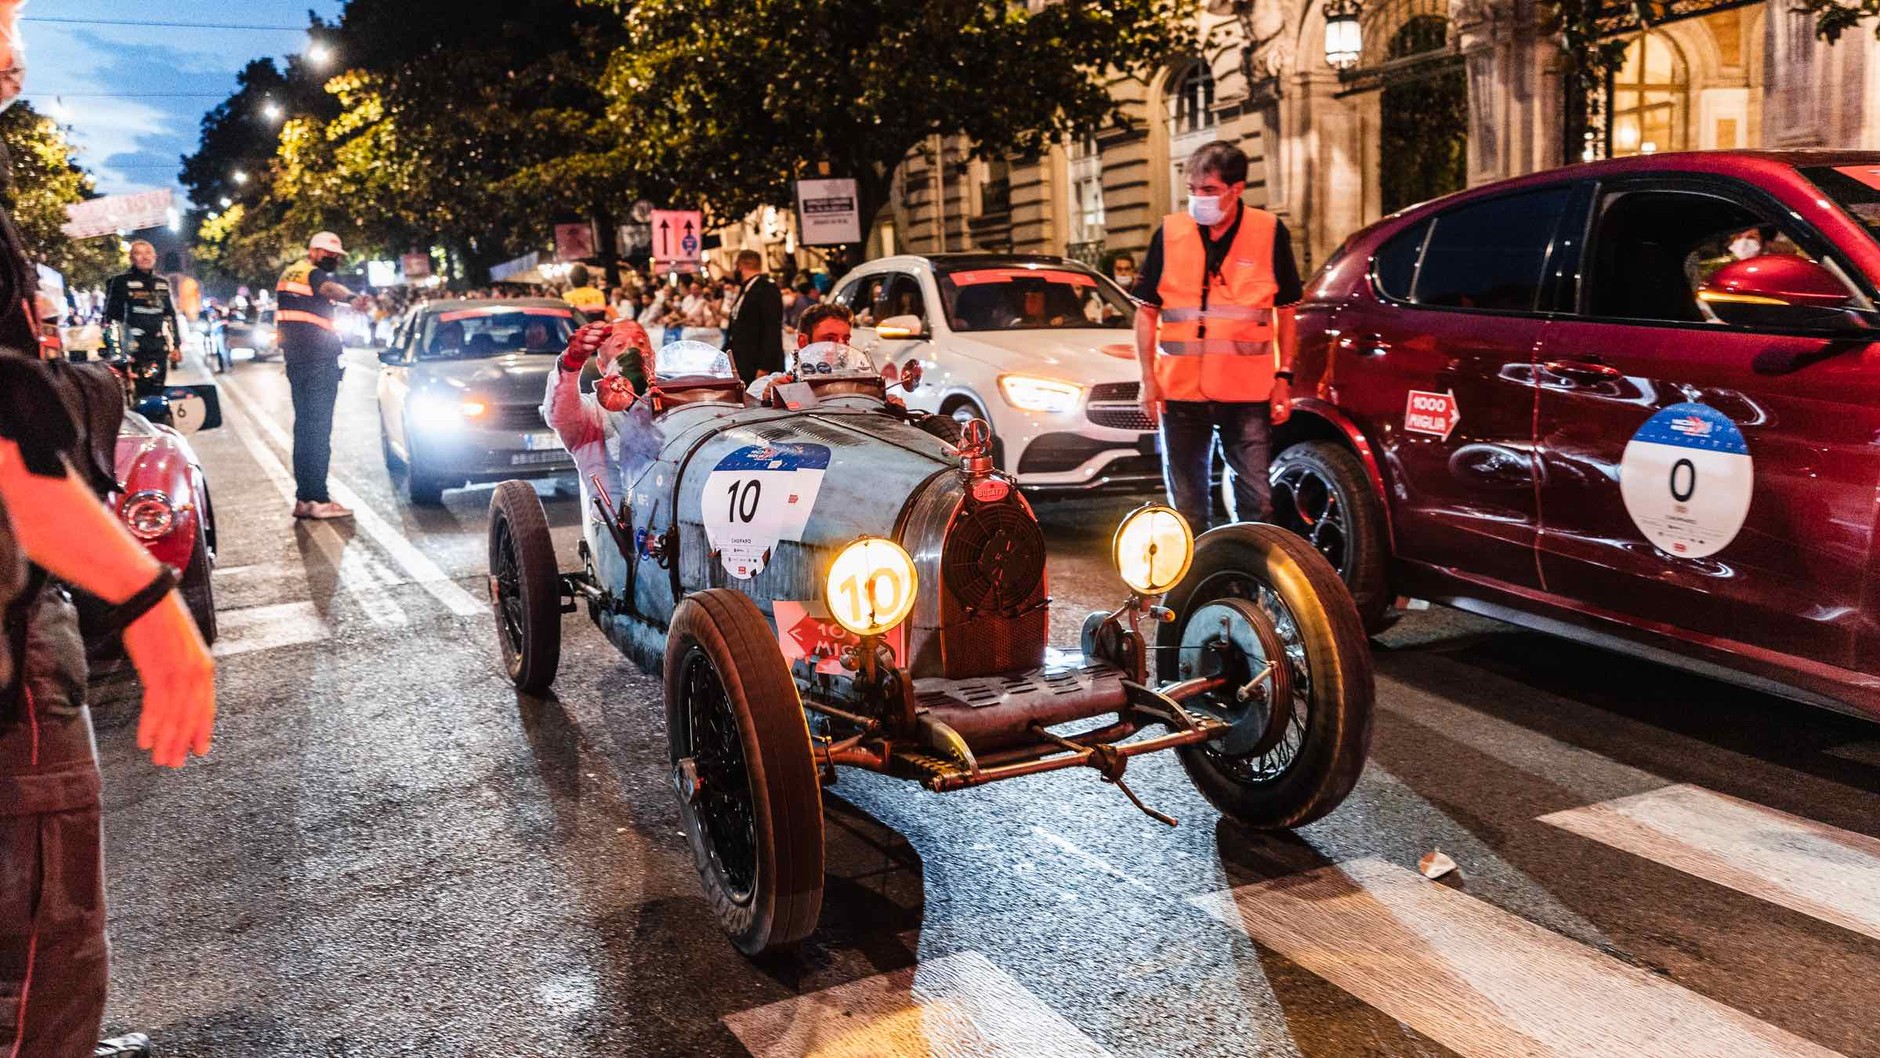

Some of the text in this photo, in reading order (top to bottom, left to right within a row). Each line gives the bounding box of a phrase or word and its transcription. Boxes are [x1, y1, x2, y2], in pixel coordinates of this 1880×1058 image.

[177, 403, 187, 418] 6
[1413, 396, 1447, 412] 1000
[1409, 413, 1446, 430] MIGLIA
[1670, 458, 1696, 502] 0
[727, 479, 761, 523] 10
[840, 567, 902, 622] 10
